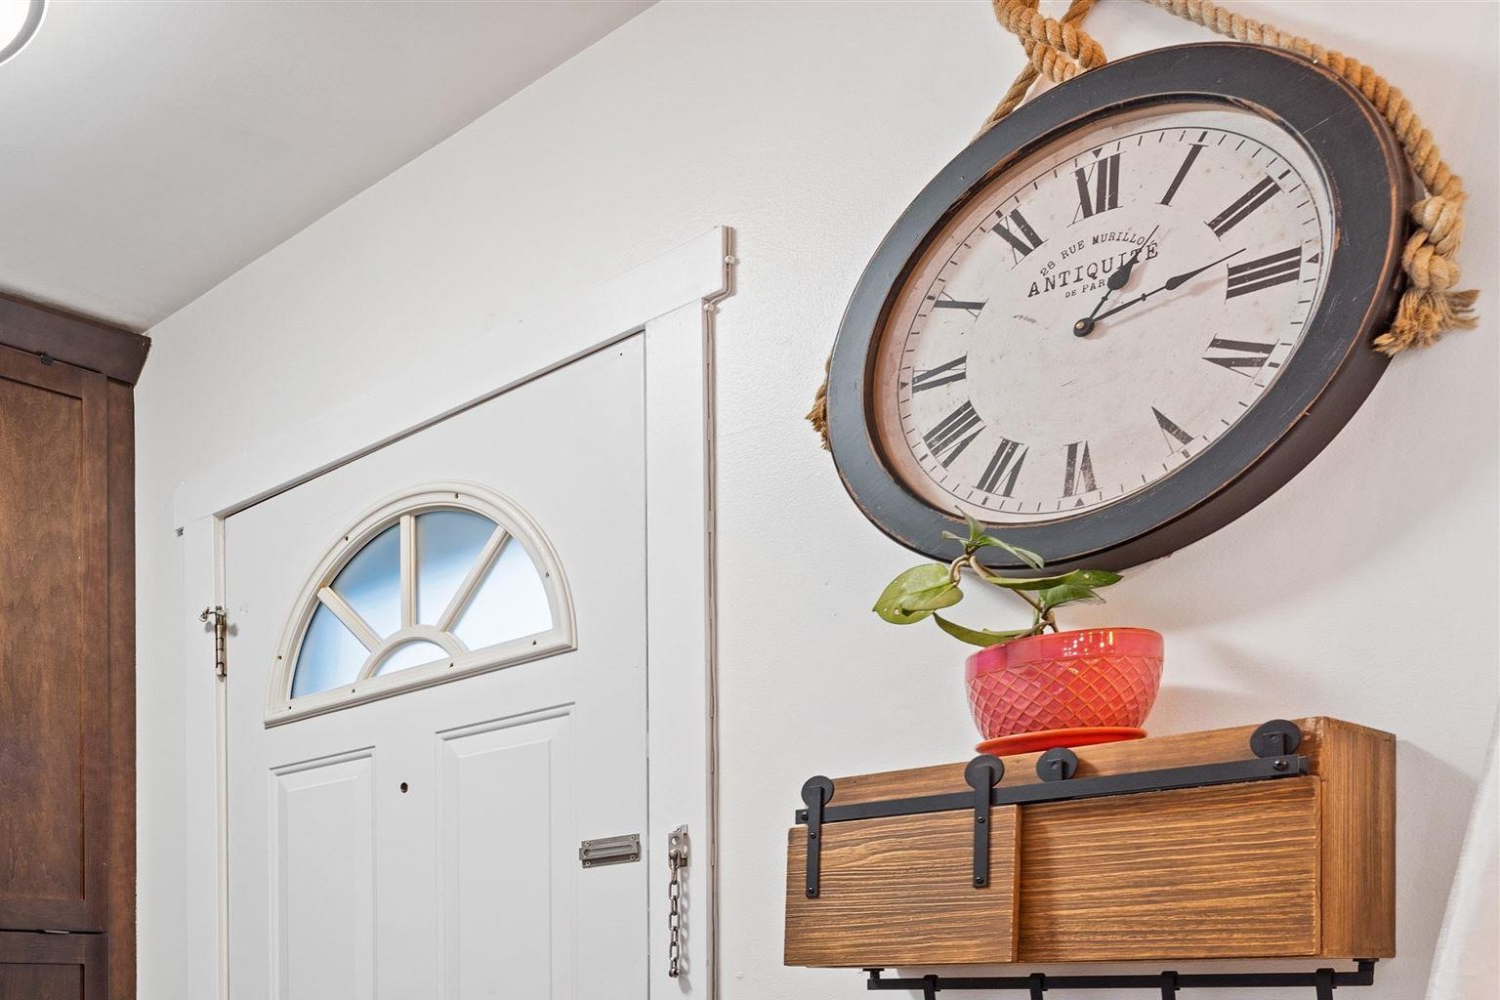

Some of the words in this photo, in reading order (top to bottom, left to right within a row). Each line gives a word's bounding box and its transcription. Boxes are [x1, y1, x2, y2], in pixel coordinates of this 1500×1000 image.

[1069, 151, 1127, 227] XII
[1158, 143, 1208, 206] I
[1204, 174, 1284, 239] II
[990, 208, 1049, 269] XI
[1040, 262, 1055, 277] 28
[1061, 240, 1085, 260] RUE
[1092, 231, 1145, 246] MURILLO
[1065, 290, 1077, 298] DE
[1226, 247, 1303, 303] III
[1203, 336, 1279, 378] IV
[1060, 439, 1102, 499] VI
